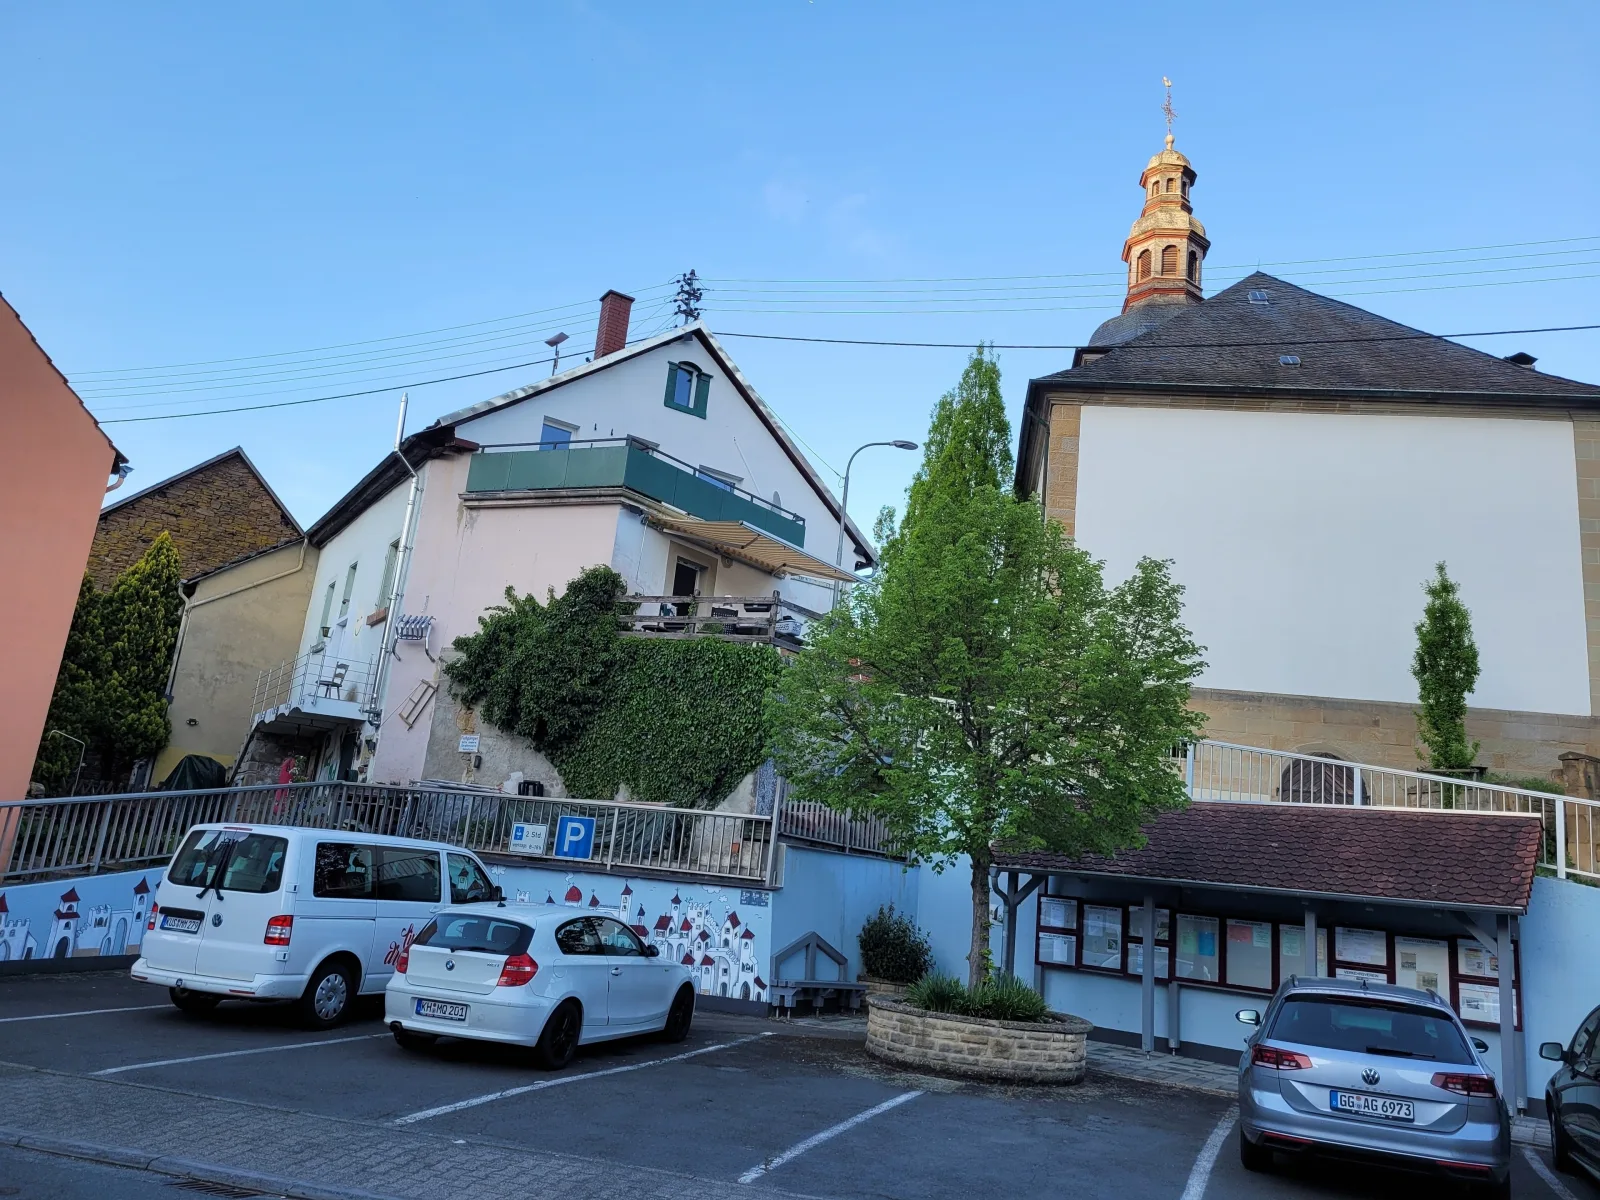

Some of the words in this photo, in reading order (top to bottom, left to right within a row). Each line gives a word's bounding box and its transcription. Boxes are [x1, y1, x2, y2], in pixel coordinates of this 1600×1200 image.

[525, 830, 530, 838] 2
[531, 831, 543, 839] Std.
[563, 822, 586, 852] P
[187, 919, 199, 930] 279
[421, 1001, 433, 1012] KH
[436, 1003, 448, 1014] MQ
[448, 1005, 464, 1017] 201
[1339, 1094, 1355, 1109] GG
[1363, 1097, 1378, 1112] AG
[1381, 1100, 1412, 1117] 6973
